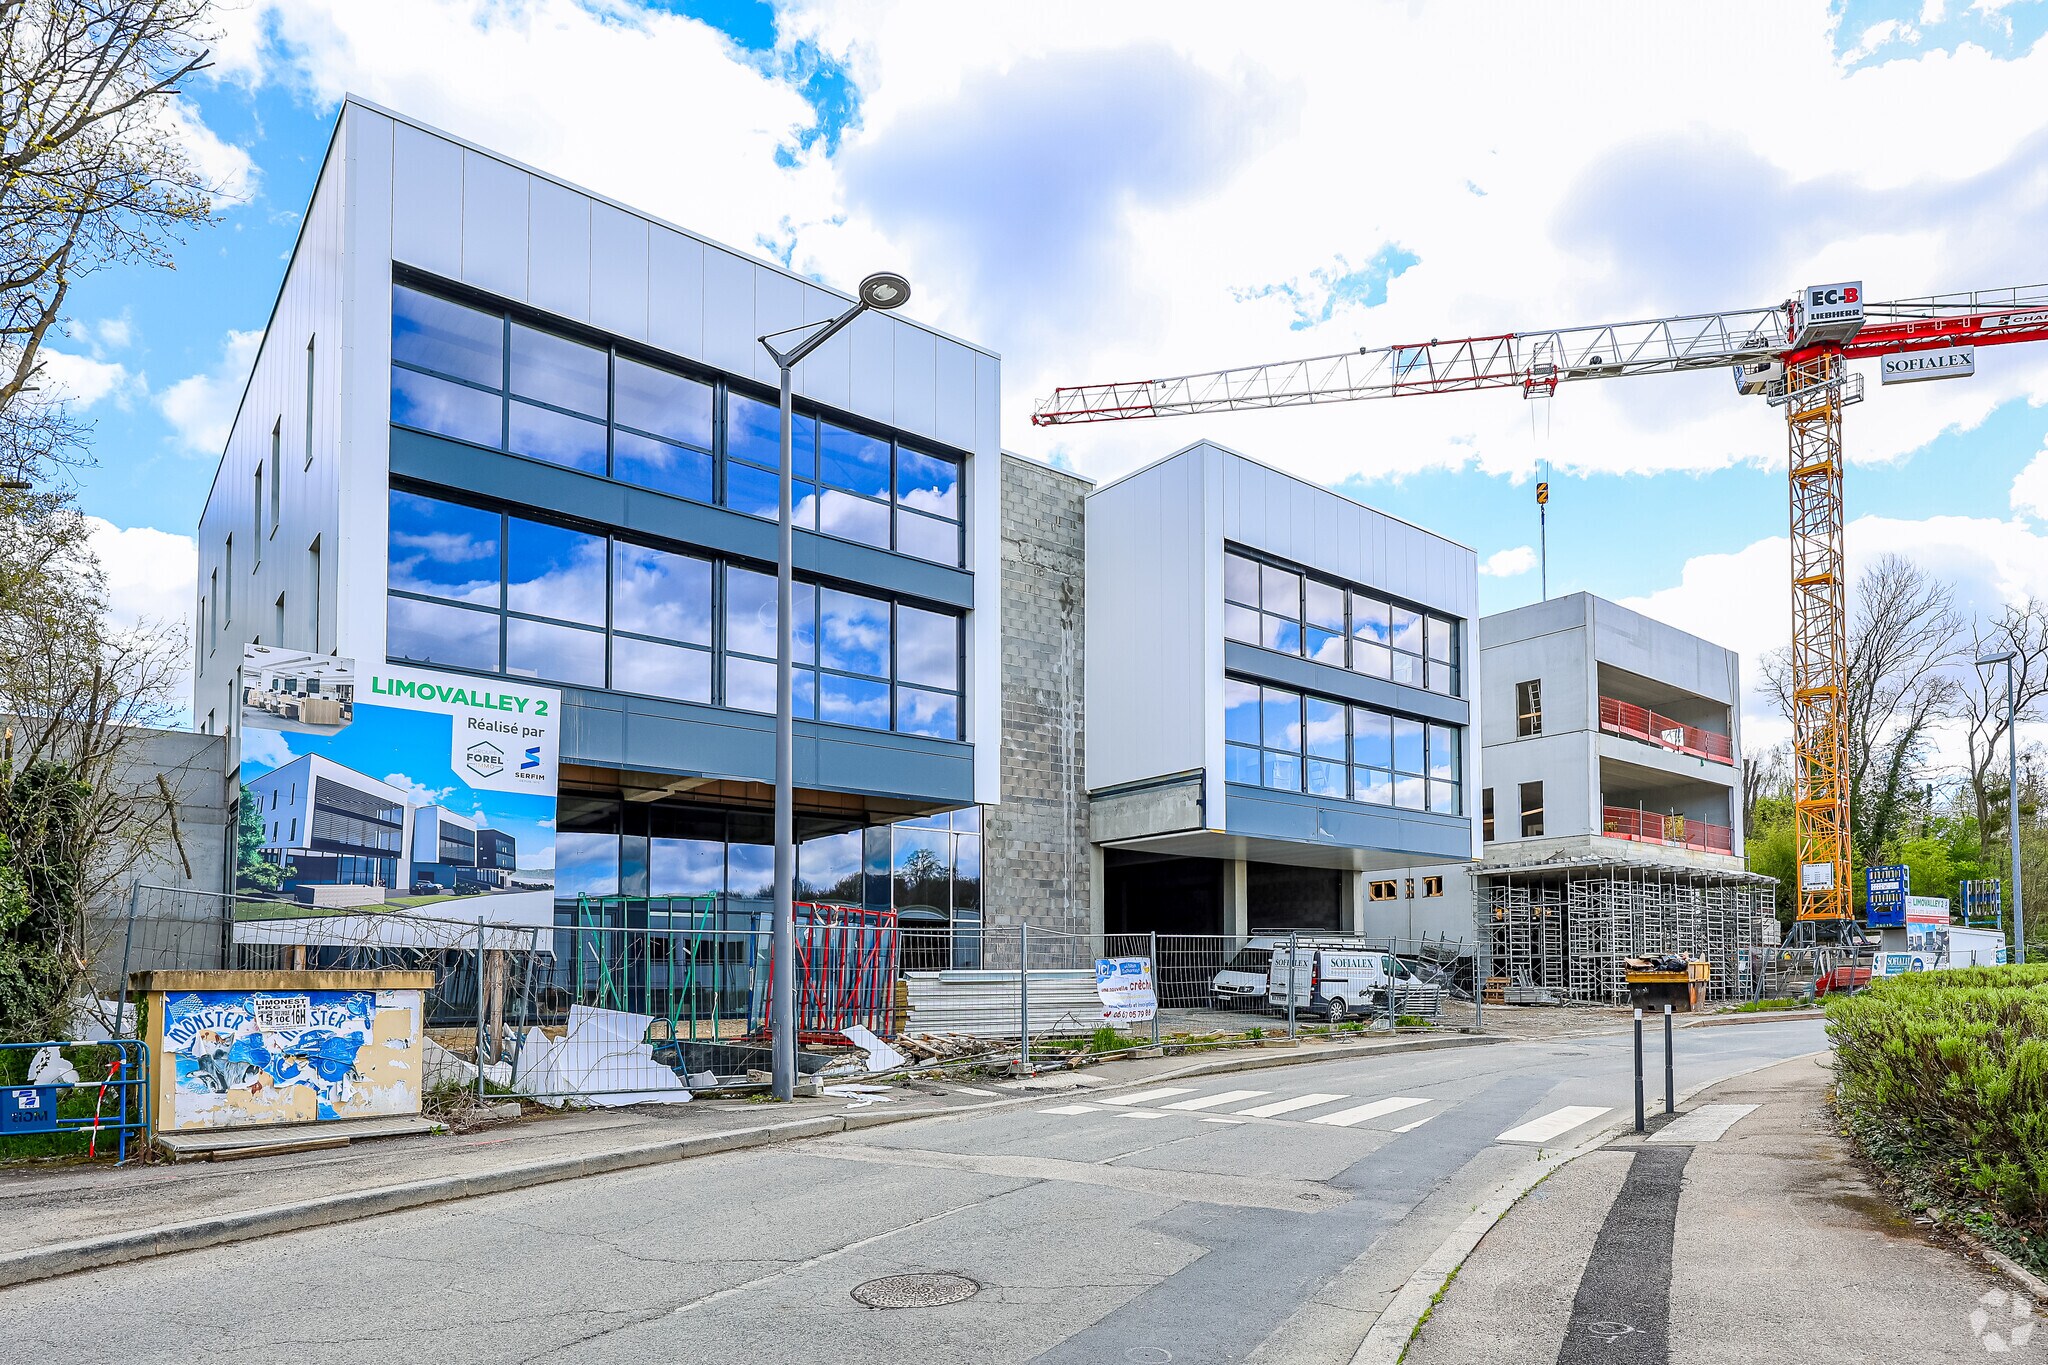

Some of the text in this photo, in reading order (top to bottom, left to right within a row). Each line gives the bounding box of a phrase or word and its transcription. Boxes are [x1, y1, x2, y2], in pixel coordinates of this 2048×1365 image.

[1812, 287, 1859, 307] EC-B
[1810, 309, 1860, 320] LIEBHERR
[1885, 353, 1972, 373] SOFIALEX
[372, 676, 548, 716] LIMOVALLEY 2
[467, 717, 545, 738] Réalisé par
[466, 753, 504, 764] FOREL
[514, 772, 545, 780] SERFIM
[1275, 959, 1308, 967] SOFILEX
[1330, 959, 1374, 968] SOFIALEX
[259, 1013, 273, 1022] 15
[291, 1009, 306, 1025] 16H
[169, 1011, 244, 1045] MONSTER
